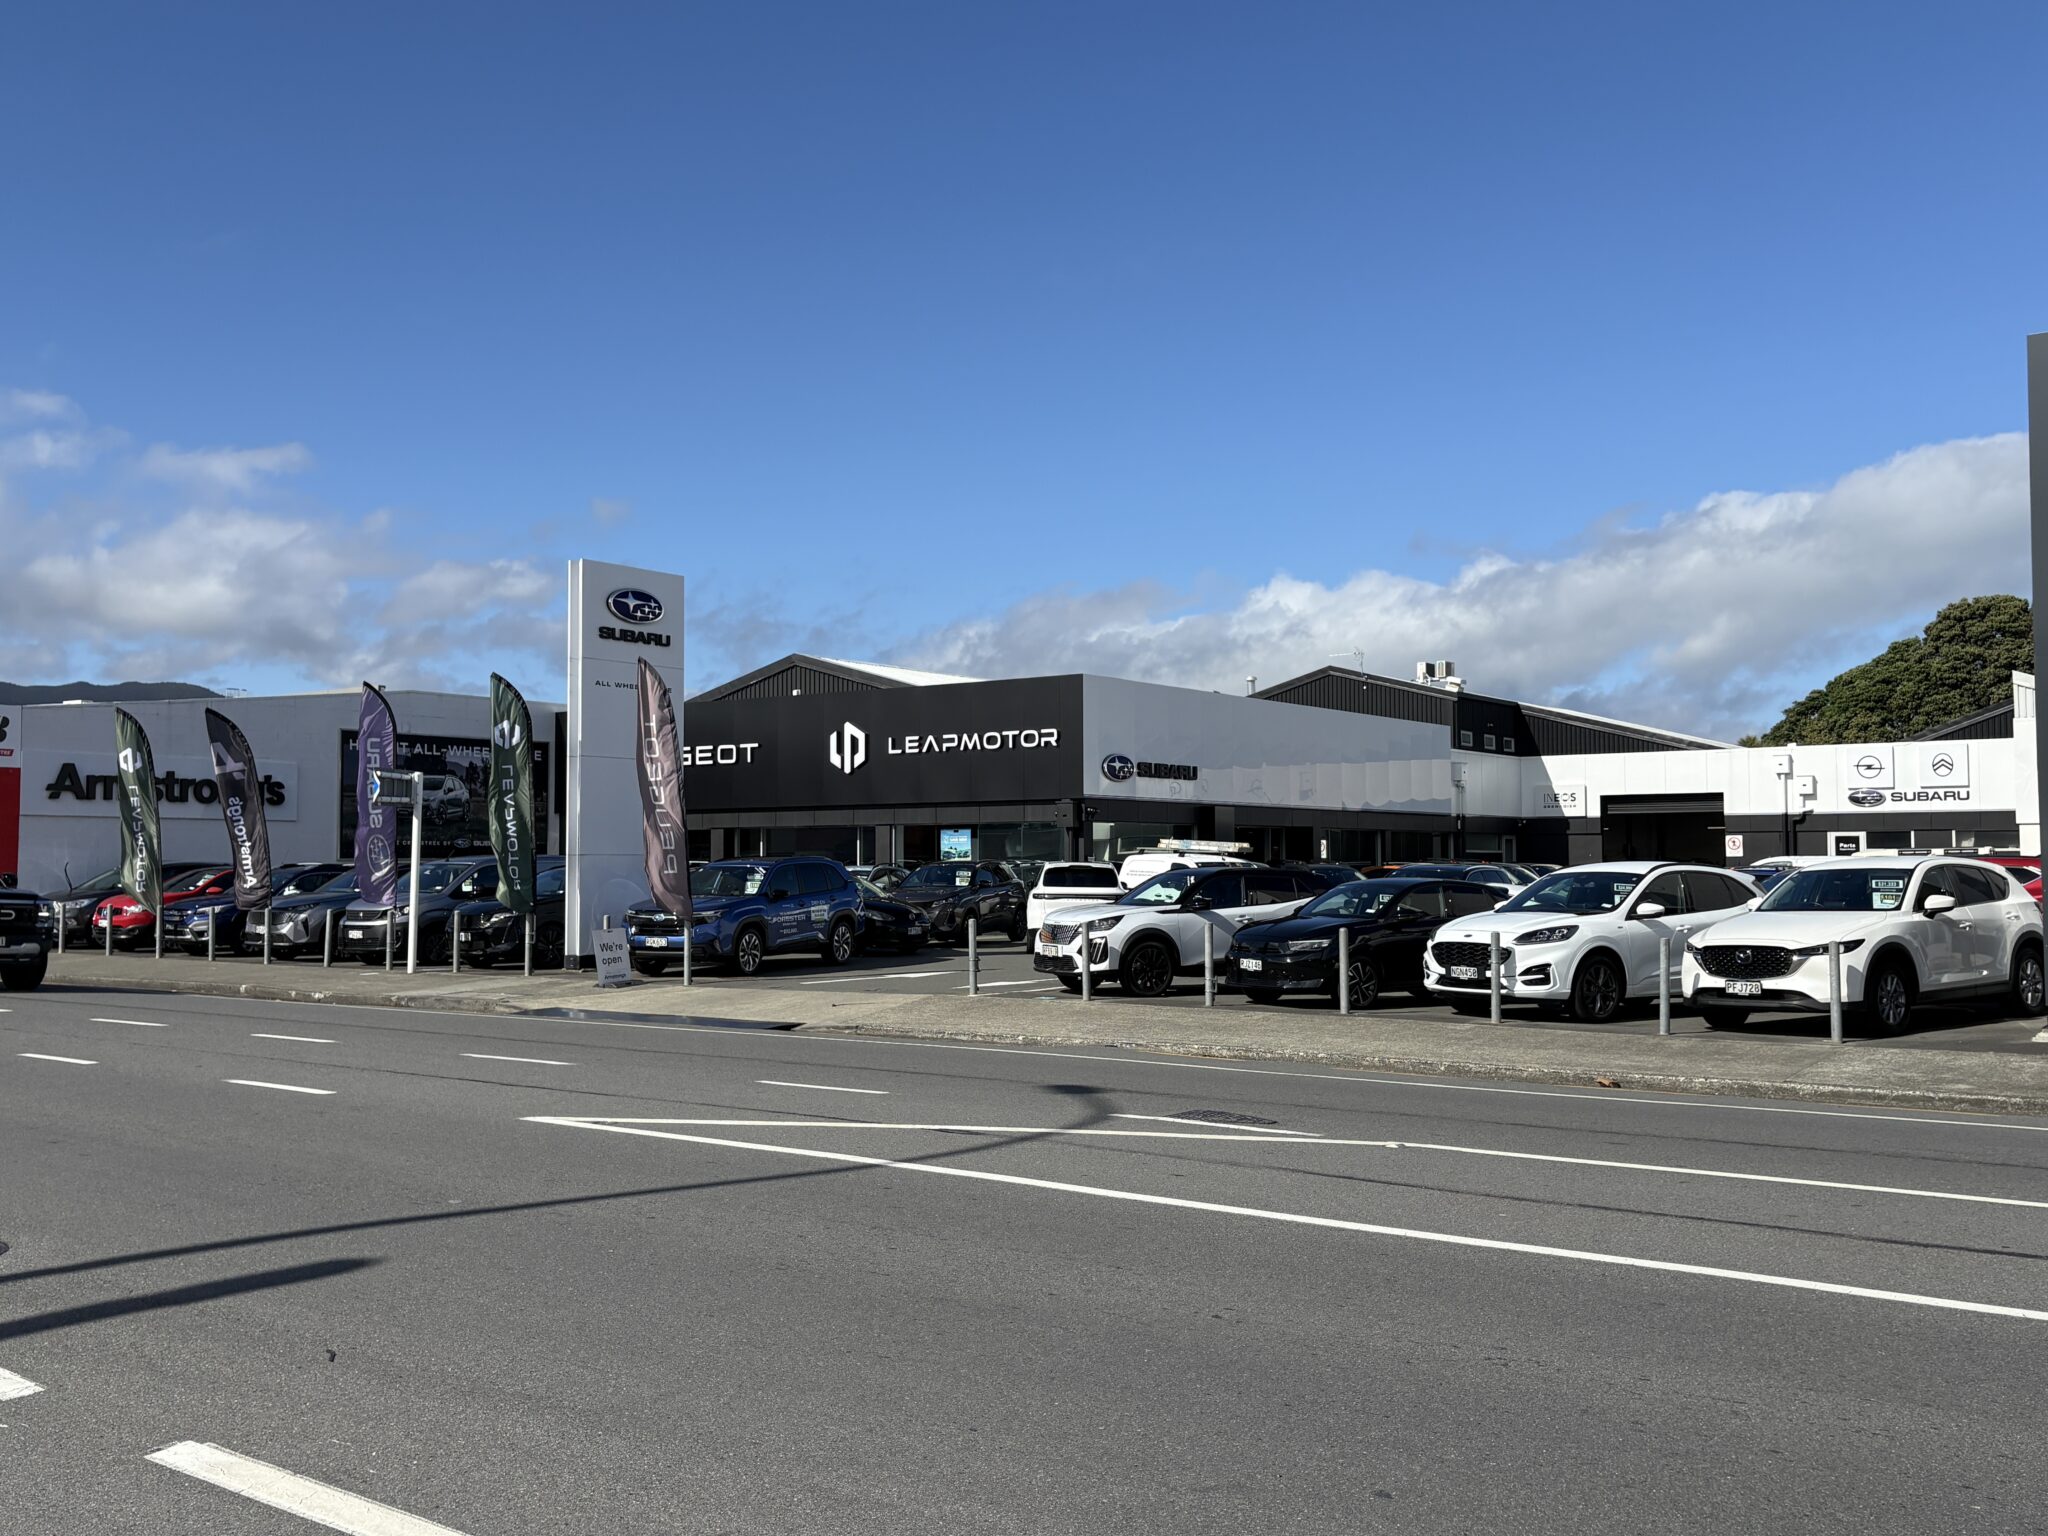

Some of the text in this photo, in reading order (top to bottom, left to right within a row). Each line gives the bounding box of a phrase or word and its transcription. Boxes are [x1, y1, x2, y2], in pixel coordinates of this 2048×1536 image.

[598, 626, 671, 648] SUBARU
[595, 680, 639, 690] ALL WHEE
[888, 728, 1058, 755] LEAPMOTOR
[413, 742, 490, 759] ALL-WHEE
[683, 743, 759, 766] GEOT
[1136, 761, 1198, 780] SUBARU
[1543, 792, 1577, 803] INEOS
[1890, 790, 1970, 802] SUBARU
[599, 942, 623, 952] We're
[602, 956, 623, 967] open
[1727, 982, 1760, 993] PFJ728
